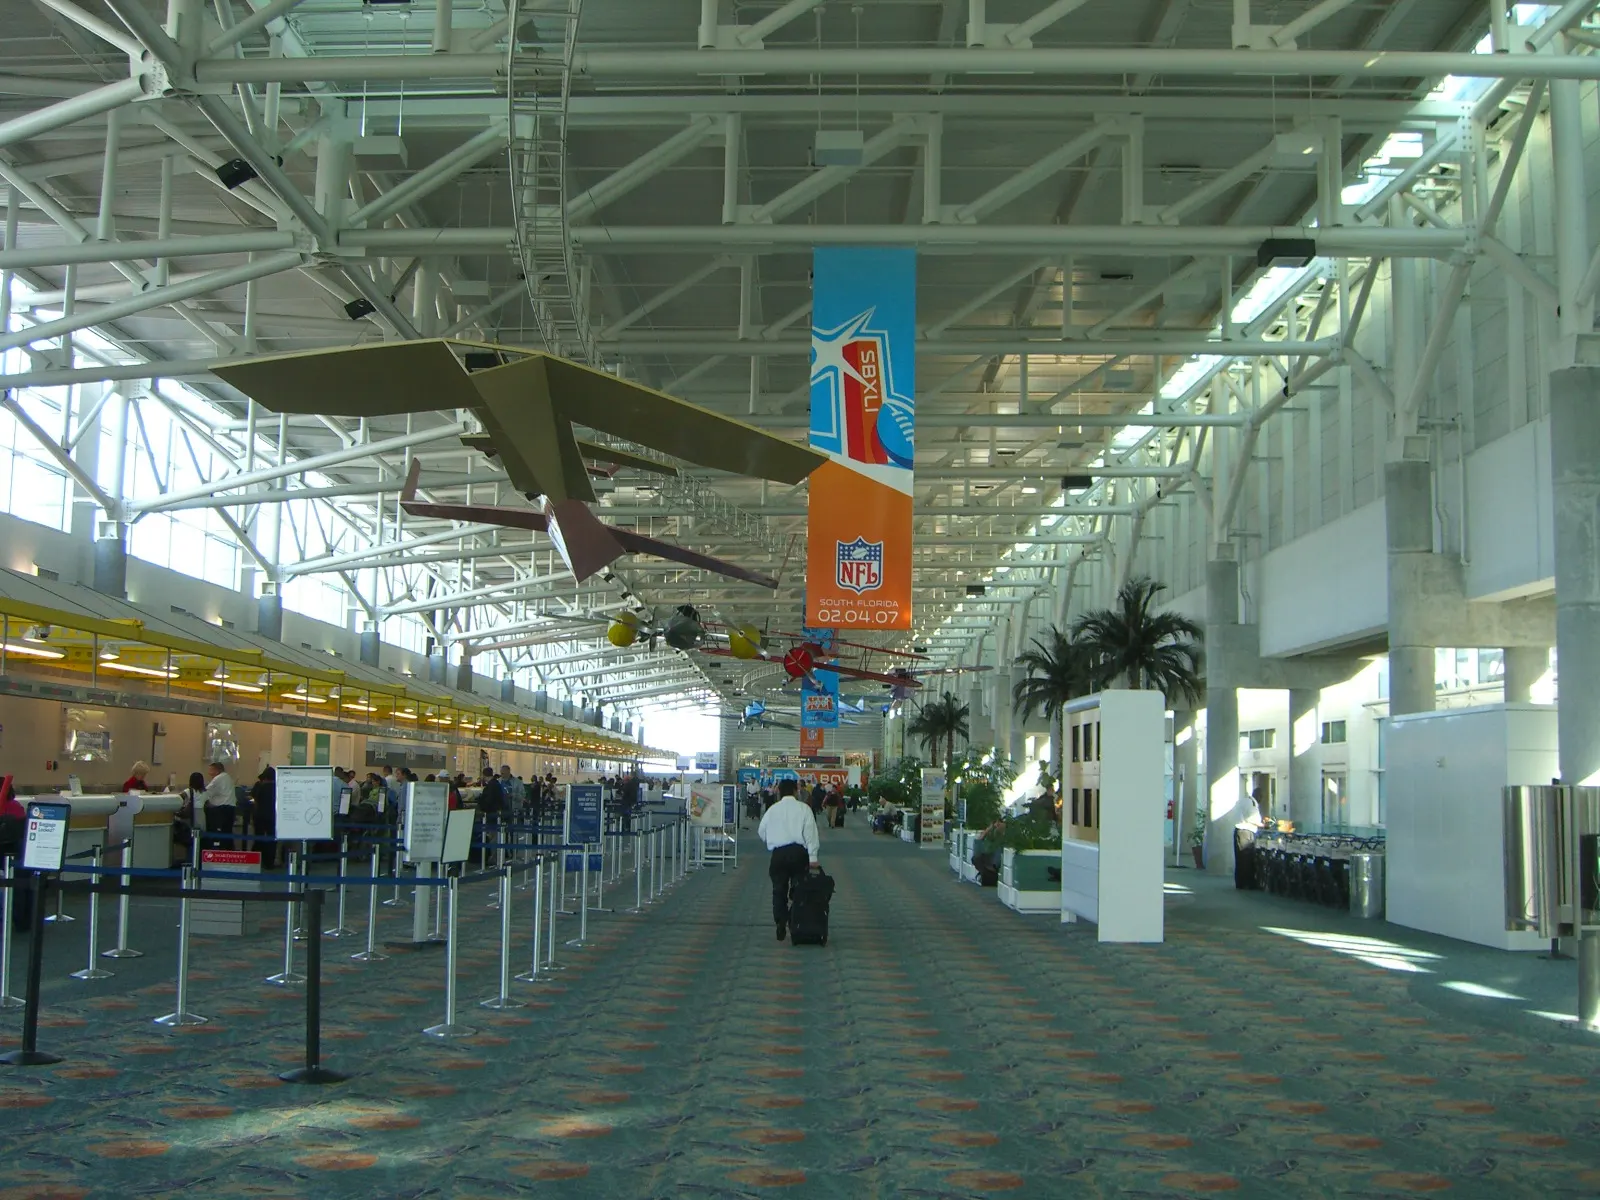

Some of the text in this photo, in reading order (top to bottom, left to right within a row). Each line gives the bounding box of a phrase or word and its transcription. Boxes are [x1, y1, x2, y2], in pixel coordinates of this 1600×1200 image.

[861, 350, 879, 412] SBXLI
[840, 561, 878, 587] NFL
[819, 598, 899, 607] SOUTH FLORIDA
[818, 609, 899, 624] 02.04.07
